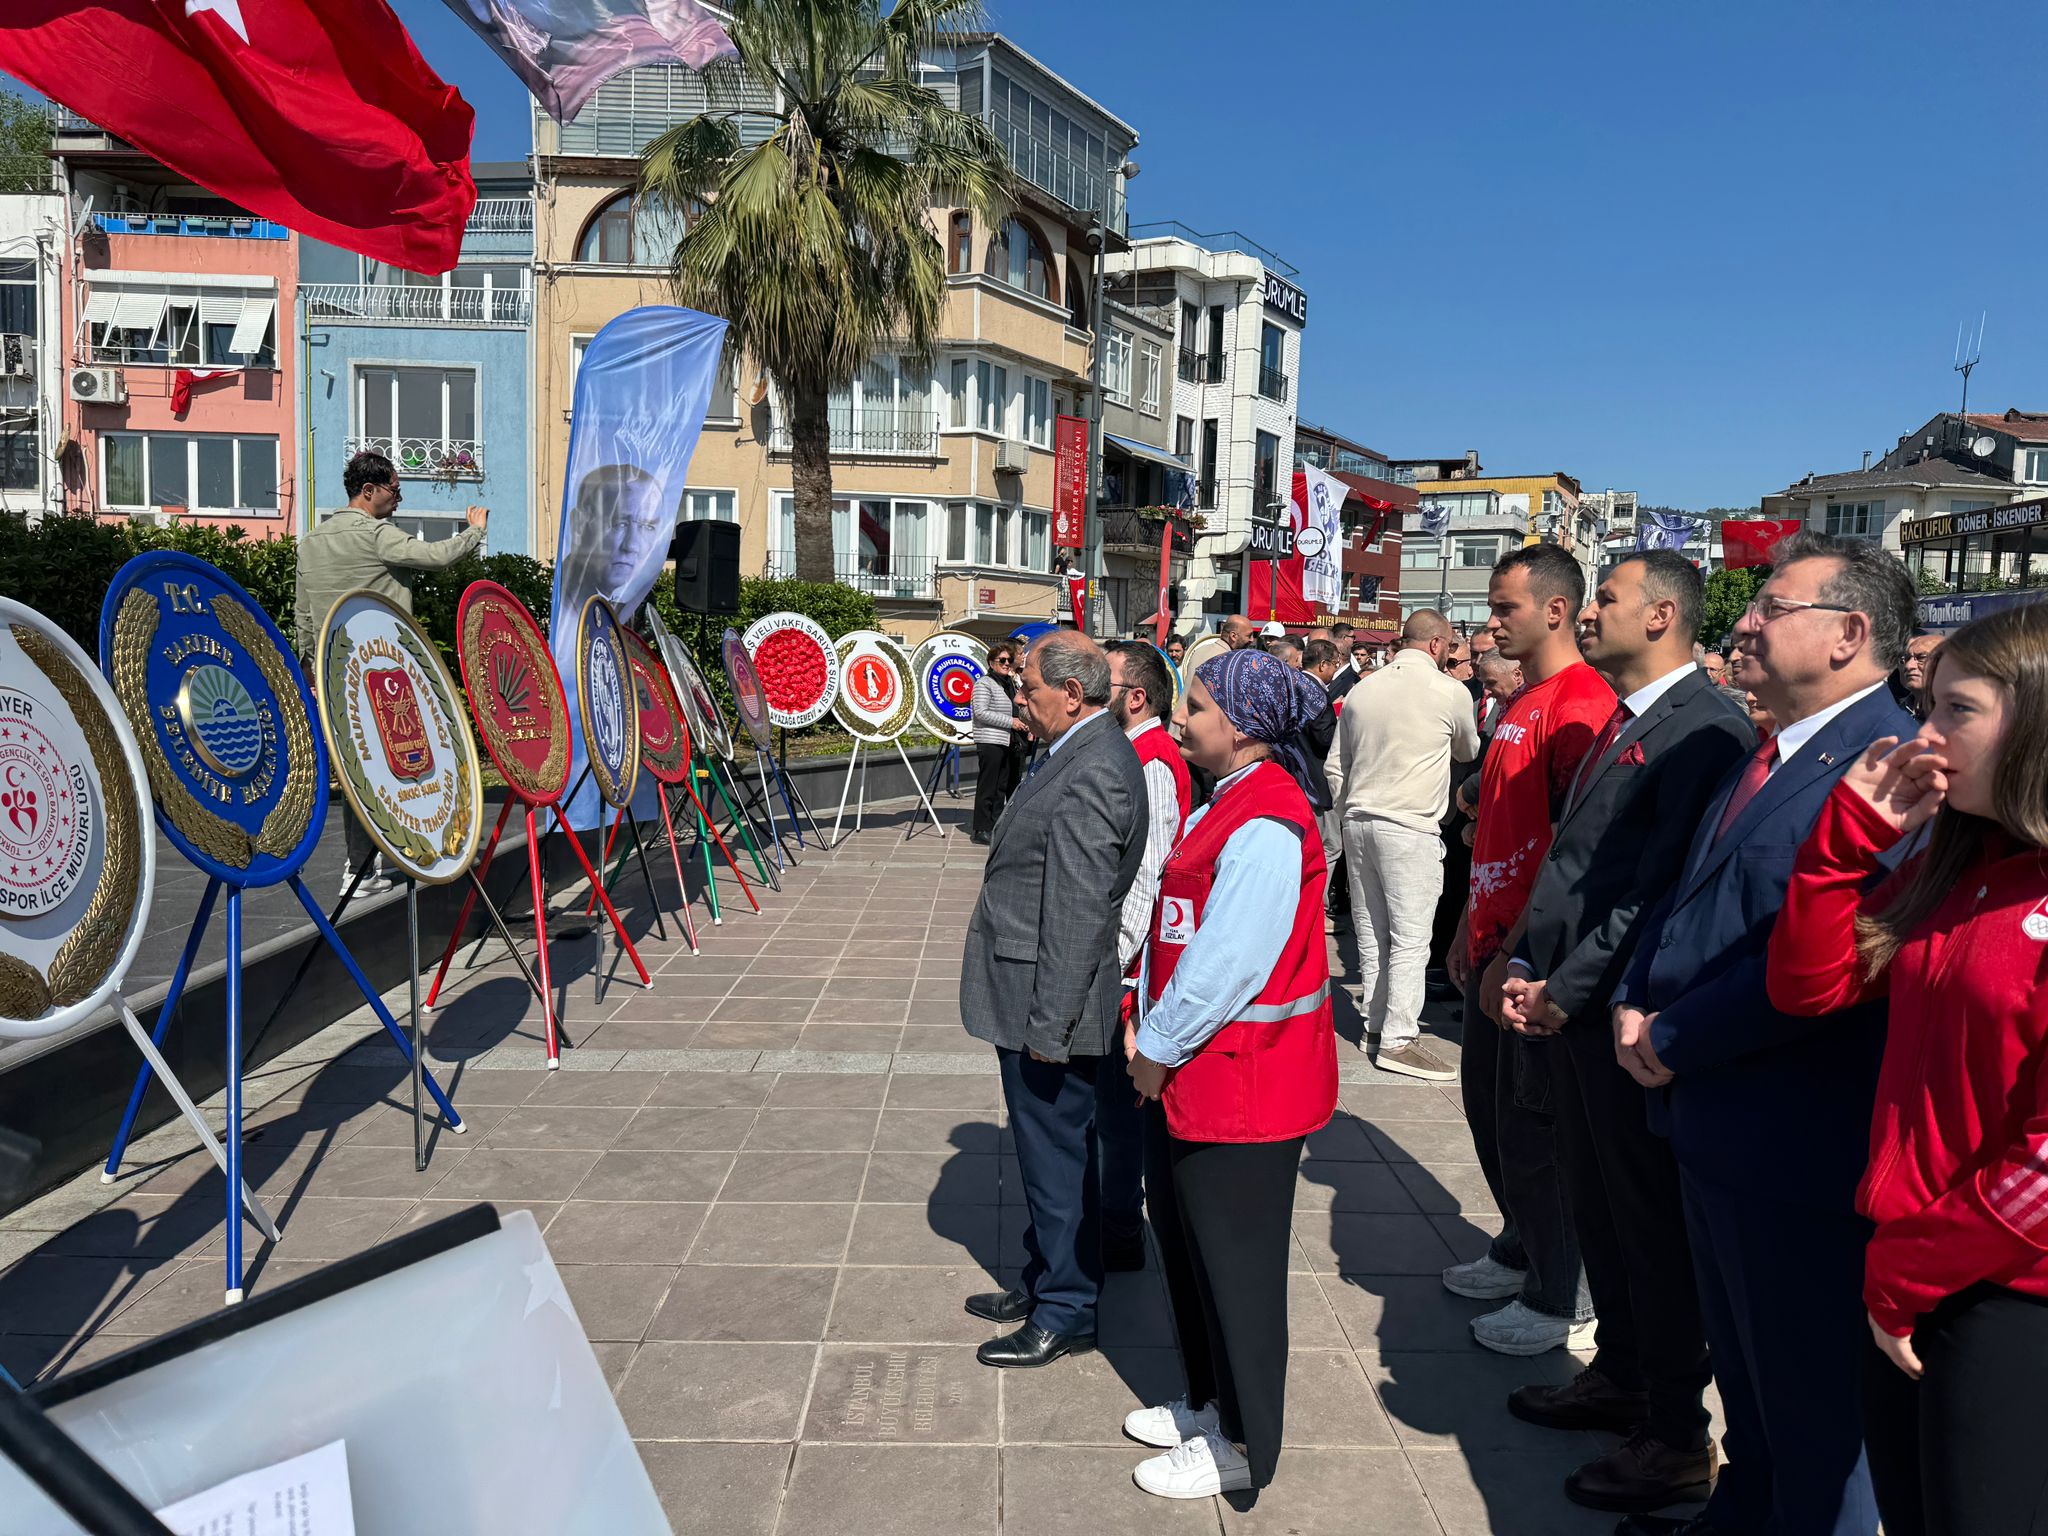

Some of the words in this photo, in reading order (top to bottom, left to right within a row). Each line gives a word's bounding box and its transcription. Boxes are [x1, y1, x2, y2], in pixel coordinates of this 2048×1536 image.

[1263, 275, 1306, 321] ÜRÜMLE
[1073, 430, 1082, 483] MEYDANI
[1071, 489, 1079, 539] SARIYER
[1901, 522, 1923, 541] HACI
[1925, 517, 1953, 537] UFUK
[1957, 511, 1988, 533] DÖNER
[1993, 504, 2042, 528] İSKENDER
[163, 633, 235, 668] SARIYER
[358, 635, 406, 667] GAZİLER
[752, 620, 773, 640] VELİ
[774, 618, 804, 629] VAKFI
[805, 624, 836, 667] SARIYER
[936, 658, 975, 673] MUHTARLAR
[942, 639, 961, 648] T.C.
[345, 658, 373, 761] MUHARİP
[407, 661, 451, 750] DERNEĞİ
[931, 675, 945, 705] SARIYER
[33, 758, 43, 772] VE
[159, 704, 233, 804] BELEDİYE
[240, 698, 278, 805] BAŞKANLIĞI
[40, 770, 55, 798] SPOR
[377, 783, 421, 833] SARIYER
[0, 888, 39, 910] SPOR
[40, 880, 70, 907] İLÇE
[67, 763, 90, 878] MÜDÜRLÜĞÜ
[0, 836, 21, 857] TÜRK
[38, 800, 56, 851] BAKANLIĞI
[841, 1361, 874, 1426] İSTANBUL
[877, 1350, 909, 1438] BÜYÜKŞEHİR
[913, 1355, 939, 1432] BELEDİYESİ
